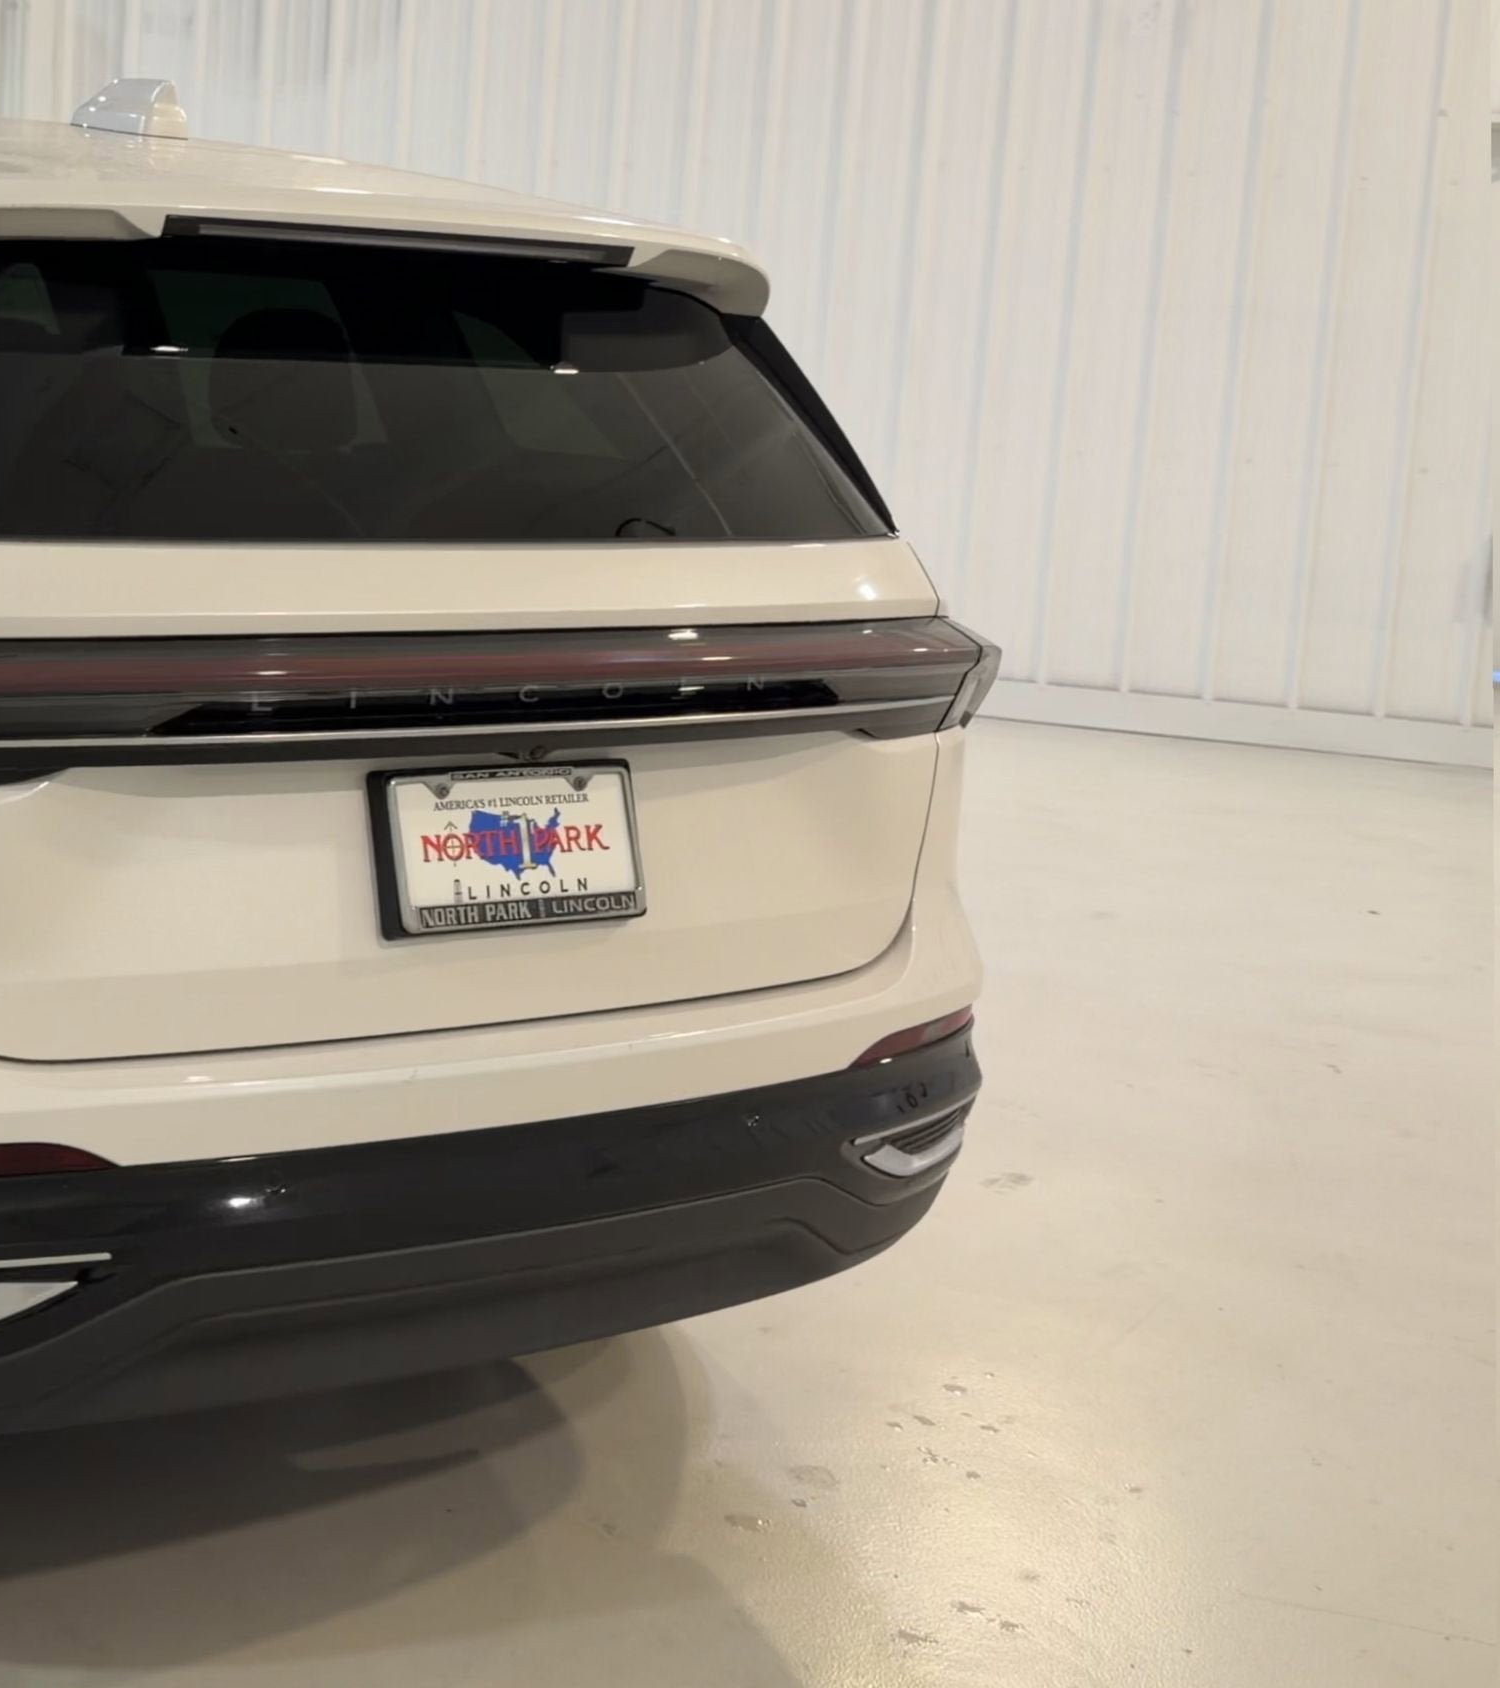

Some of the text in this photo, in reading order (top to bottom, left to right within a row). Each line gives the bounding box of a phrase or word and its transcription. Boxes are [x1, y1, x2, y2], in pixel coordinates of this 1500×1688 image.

[433, 797, 486, 812] AMERICA'S
[500, 795, 544, 808] LINCOLN
[545, 793, 589, 805] RETAILER
[421, 823, 610, 863] NORTH PARK
[468, 877, 589, 900] LINCOLN
[420, 894, 636, 929] NORTH PARK LINCOLN
